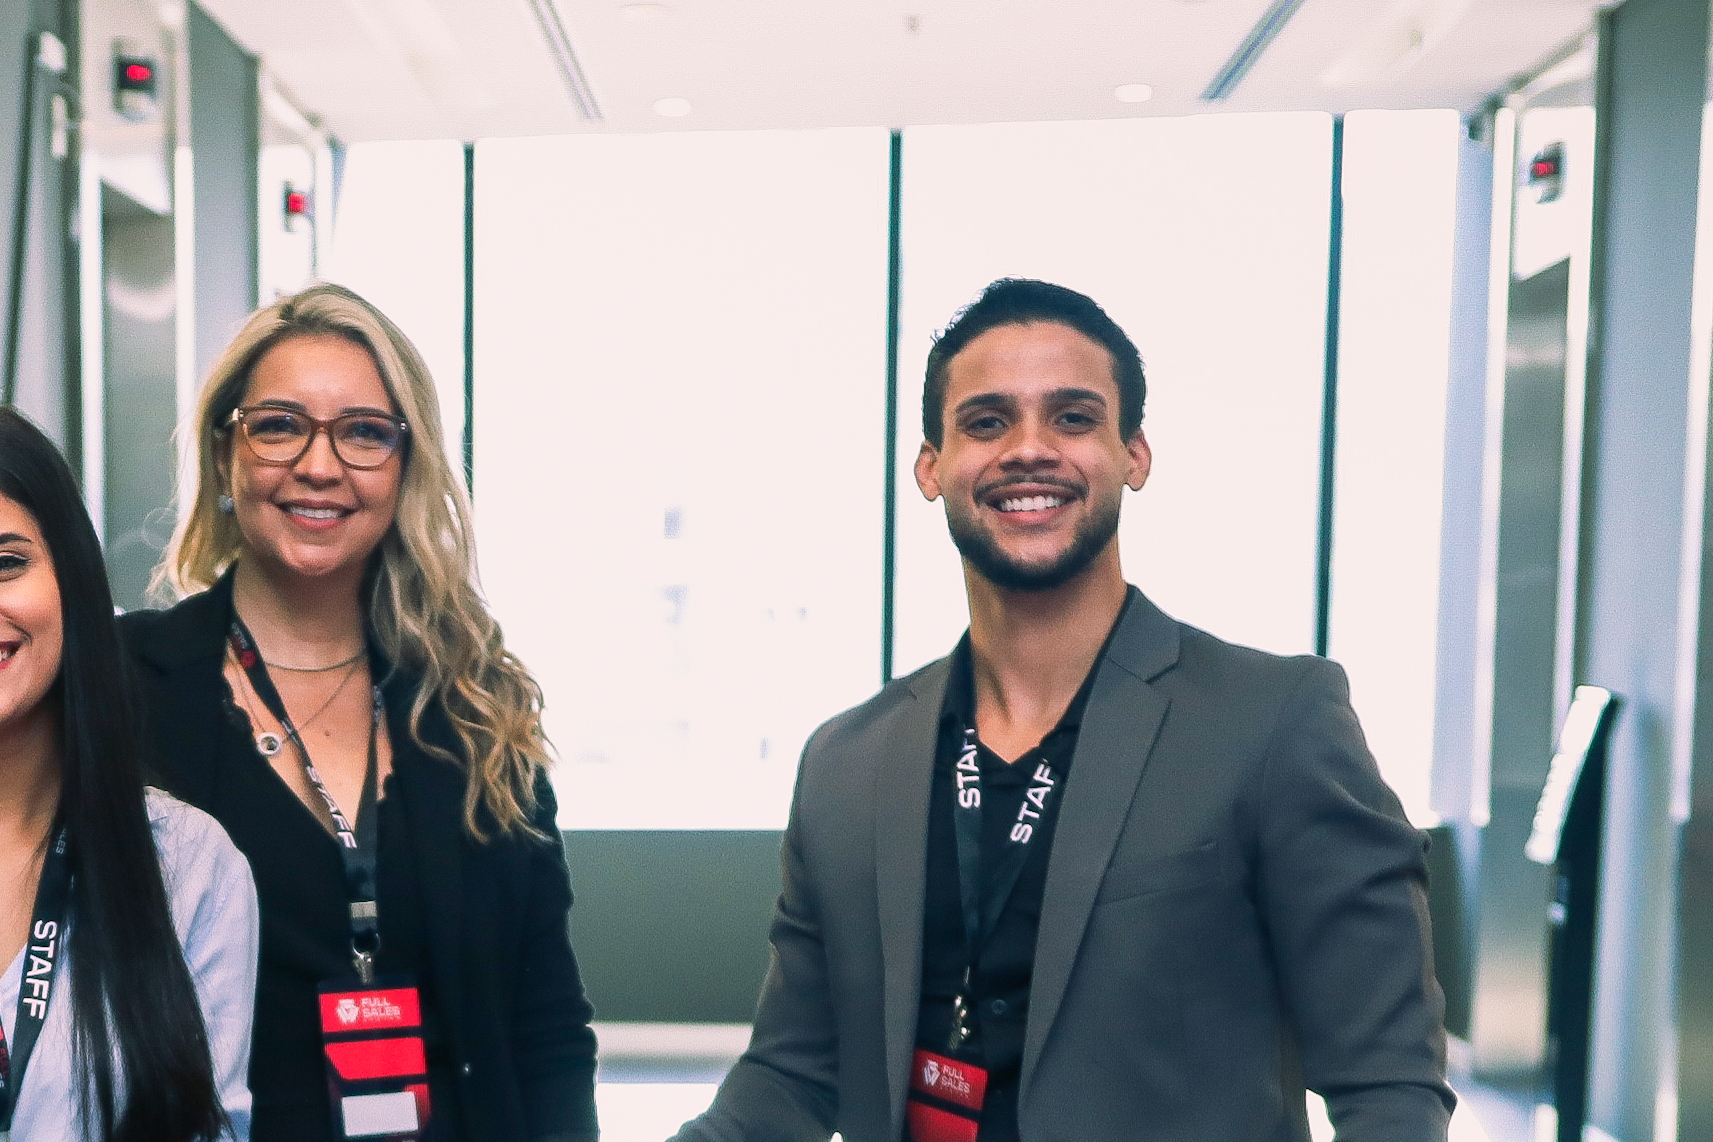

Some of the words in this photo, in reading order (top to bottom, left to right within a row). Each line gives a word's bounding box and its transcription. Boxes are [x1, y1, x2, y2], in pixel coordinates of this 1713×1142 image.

[1010, 758, 1054, 844] STAF
[23, 919, 58, 1020] STAFF
[361, 997, 391, 1007] FULL
[363, 1006, 401, 1018] SALES
